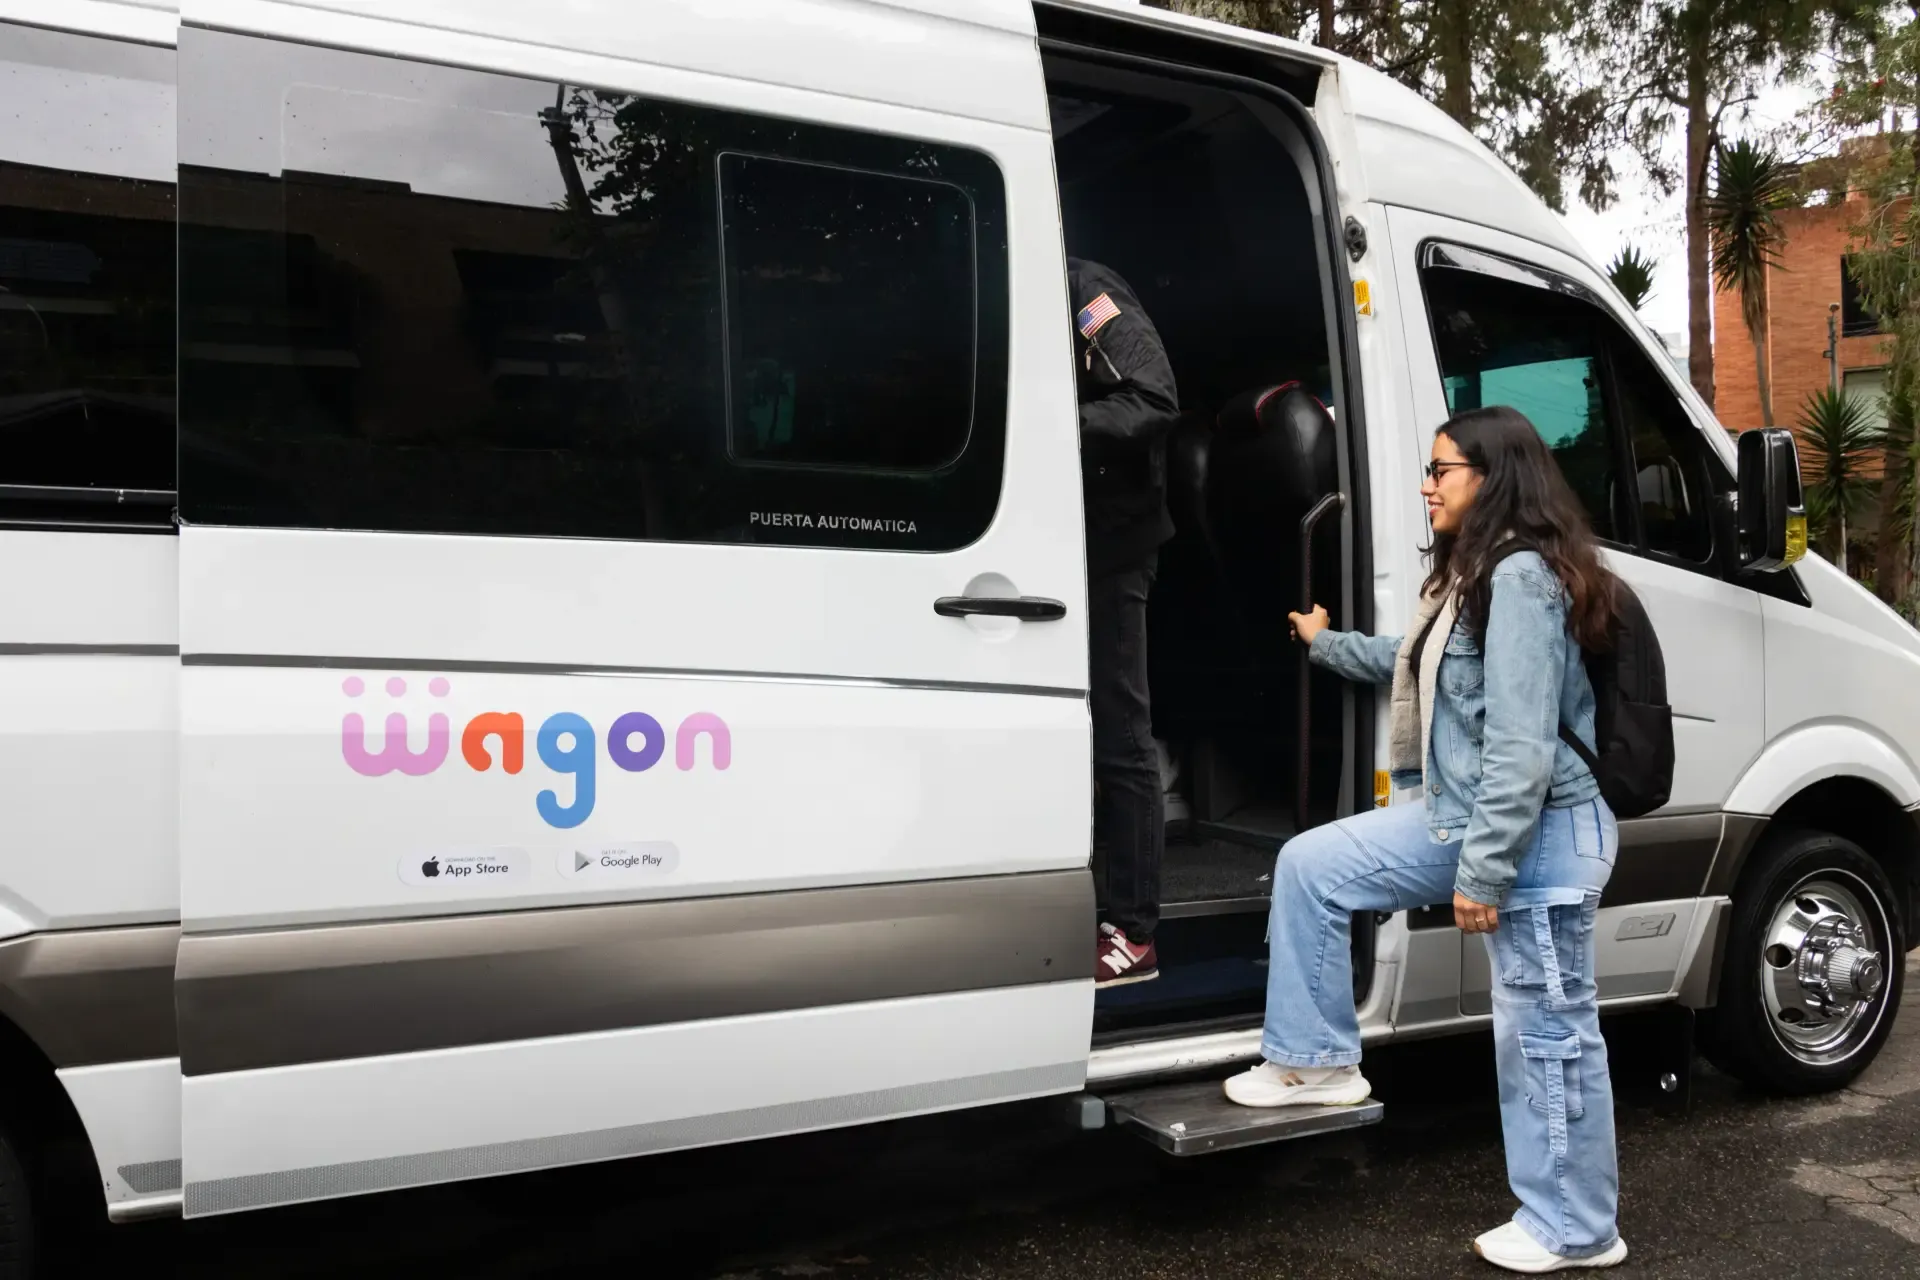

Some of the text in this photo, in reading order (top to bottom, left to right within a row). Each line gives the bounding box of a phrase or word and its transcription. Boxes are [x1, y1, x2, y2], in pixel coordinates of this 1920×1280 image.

[750, 511, 917, 533] PUERTA AUTOMATICA
[342, 676, 731, 829] wagon
[445, 863, 509, 877] App Store
[600, 854, 663, 869] Google Play
